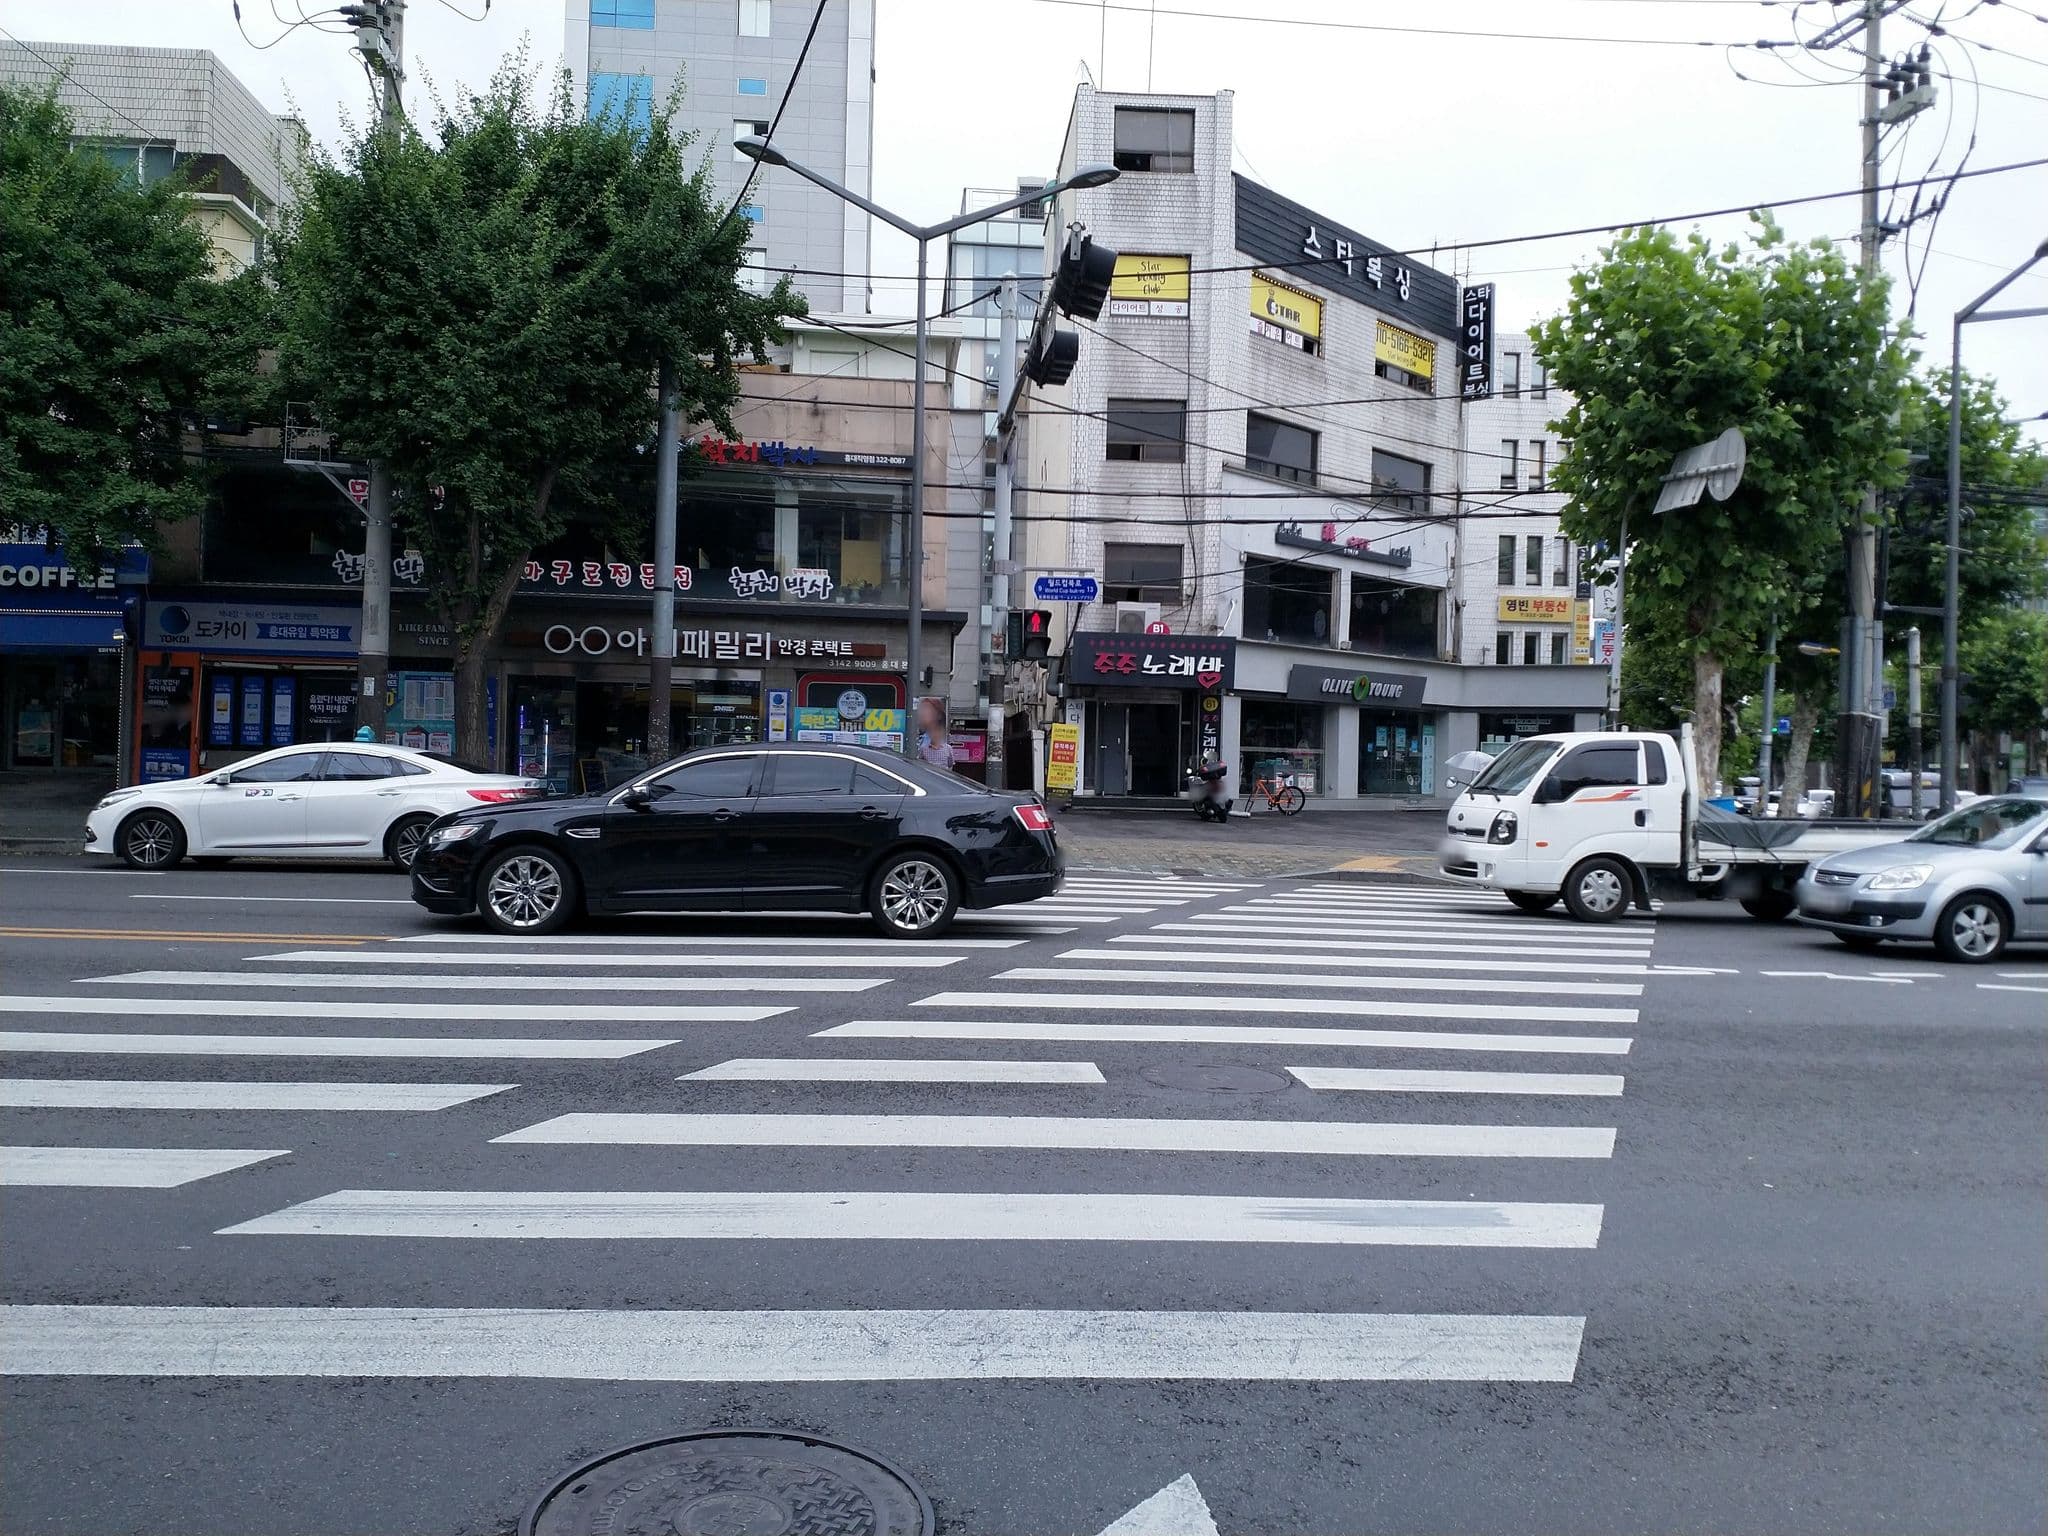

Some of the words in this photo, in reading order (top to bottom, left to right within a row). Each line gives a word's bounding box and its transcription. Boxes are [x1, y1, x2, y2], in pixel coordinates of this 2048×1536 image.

[1141, 261, 1161, 272] Star
[1304, 226, 1410, 300] 스타복싱
[1143, 284, 1161, 295] Club
[1465, 286, 1491, 302] 스타
[1112, 303, 1146, 313] 다이어트
[1467, 301, 1487, 381] 다이어트
[1464, 381, 1489, 399] 복싱
[700, 435, 822, 467] 참치박사
[729, 566, 779, 597] 참치
[783, 574, 834, 600] 박사
[1506, 599, 1529, 612] 영빈
[1533, 600, 1568, 613] 부동산
[195, 621, 247, 640] 도카이
[425, 624, 449, 633] FAM
[1153, 624, 1164, 634] B1
[418, 636, 450, 646] SINCE
[778, 638, 807, 656] 안경
[809, 639, 854, 657] 콘택트
[828, 659, 851, 668] 3142
[854, 660, 877, 669] 9009
[1094, 652, 1138, 674] 주주
[1141, 653, 1225, 688] 노래방
[1321, 678, 1355, 694] OLIVE
[1369, 681, 1403, 698] YOUNG
[309, 703, 325, 713] 하지
[326, 704, 348, 714] 마세요
